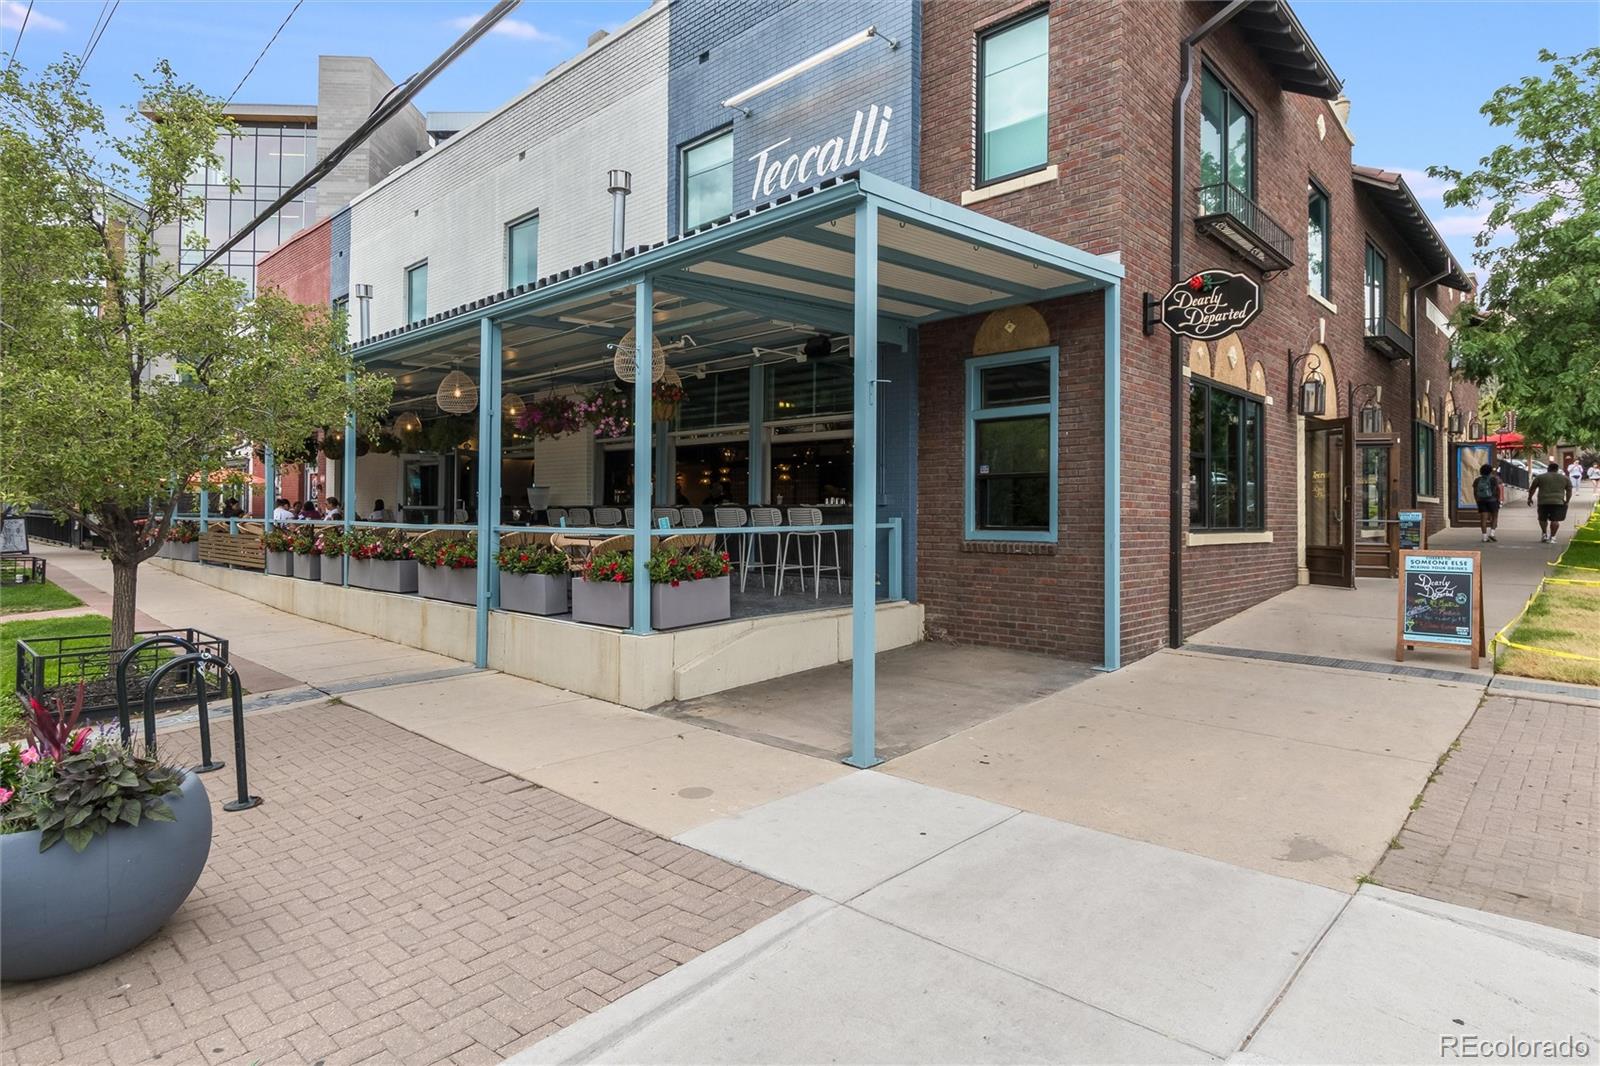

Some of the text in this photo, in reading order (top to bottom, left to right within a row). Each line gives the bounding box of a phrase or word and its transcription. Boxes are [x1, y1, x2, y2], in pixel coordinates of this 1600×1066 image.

[748, 104, 893, 201] Teocalli
[1167, 286, 1228, 314] Dearly
[1178, 299, 1252, 334] Departed
[1414, 573, 1457, 594] Dearly
